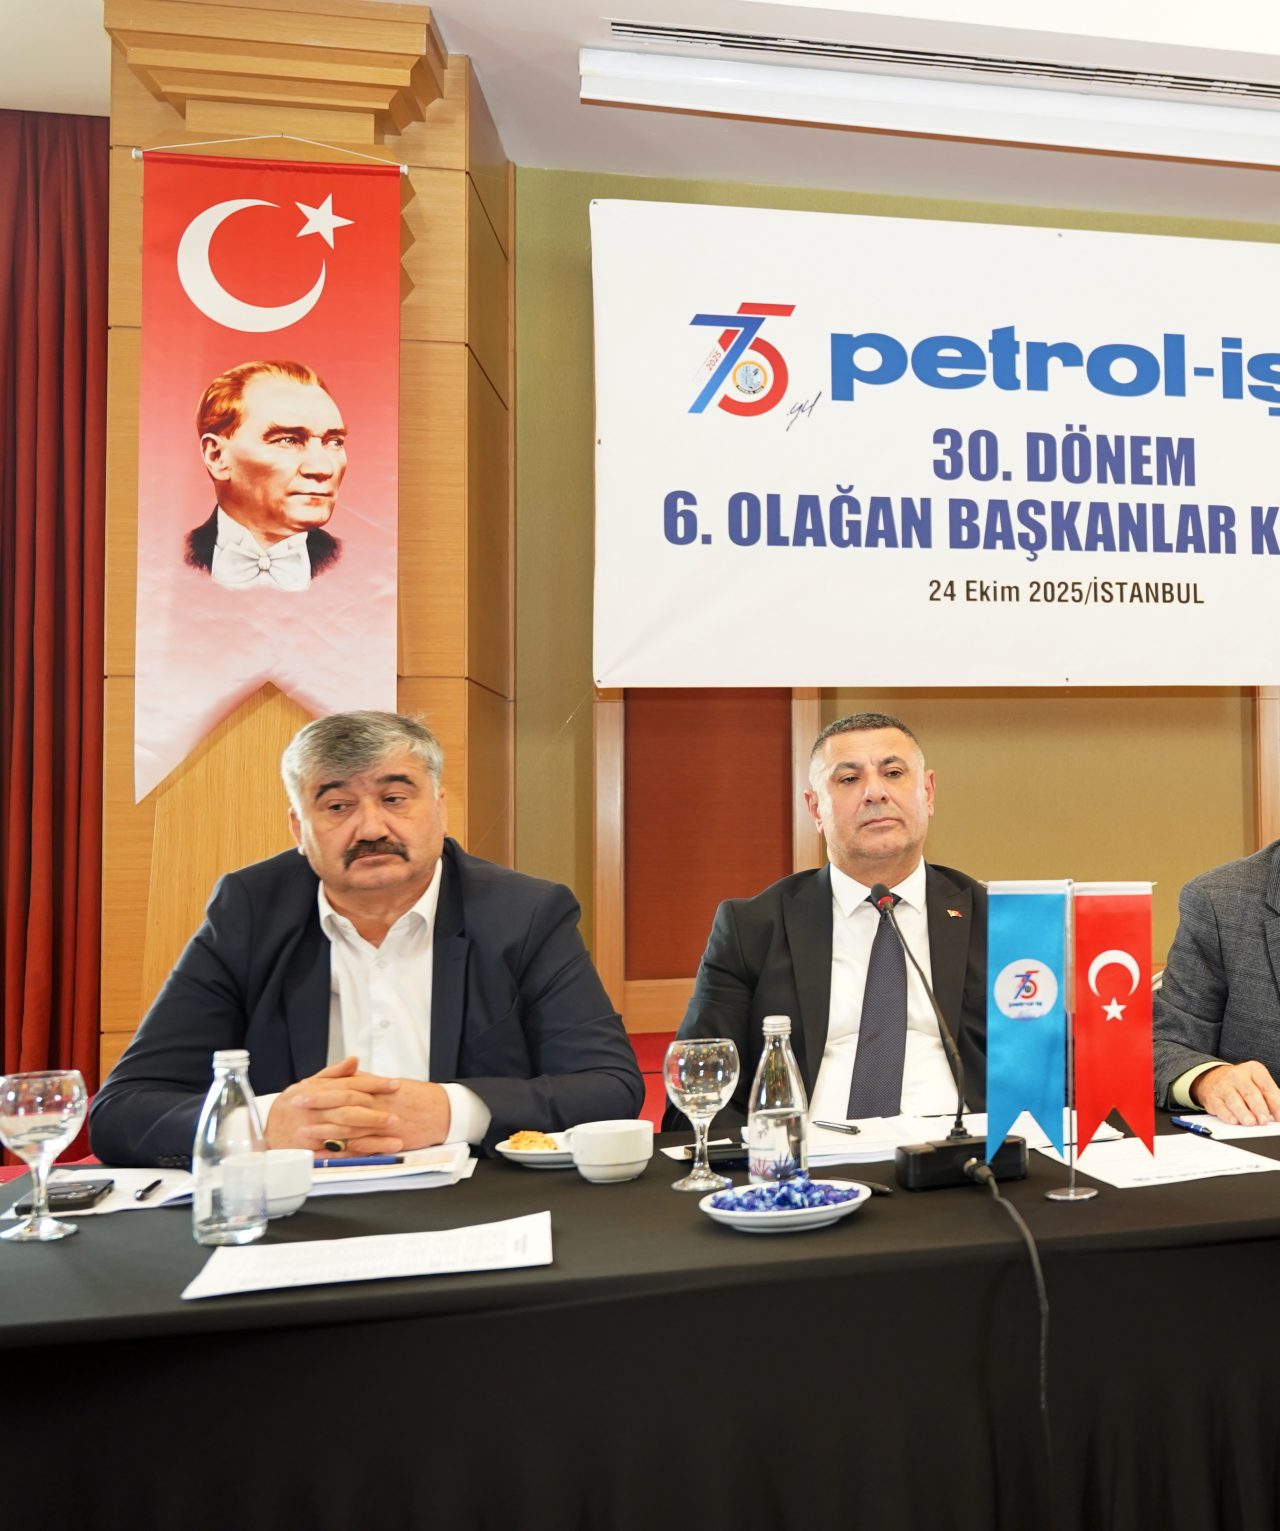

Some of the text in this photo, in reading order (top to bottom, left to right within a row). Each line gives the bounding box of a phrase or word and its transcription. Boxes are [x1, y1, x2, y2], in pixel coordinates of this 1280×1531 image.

[706, 350, 722, 371] 2025
[932, 423, 1196, 487] 30. DÖNEM
[663, 490, 712, 546] 6.
[728, 484, 932, 549] OLAĞAN
[948, 498, 1237, 562] BAŞKANLAR
[929, 575, 1205, 606] 24 Ekim 2025/İSTANBUL
